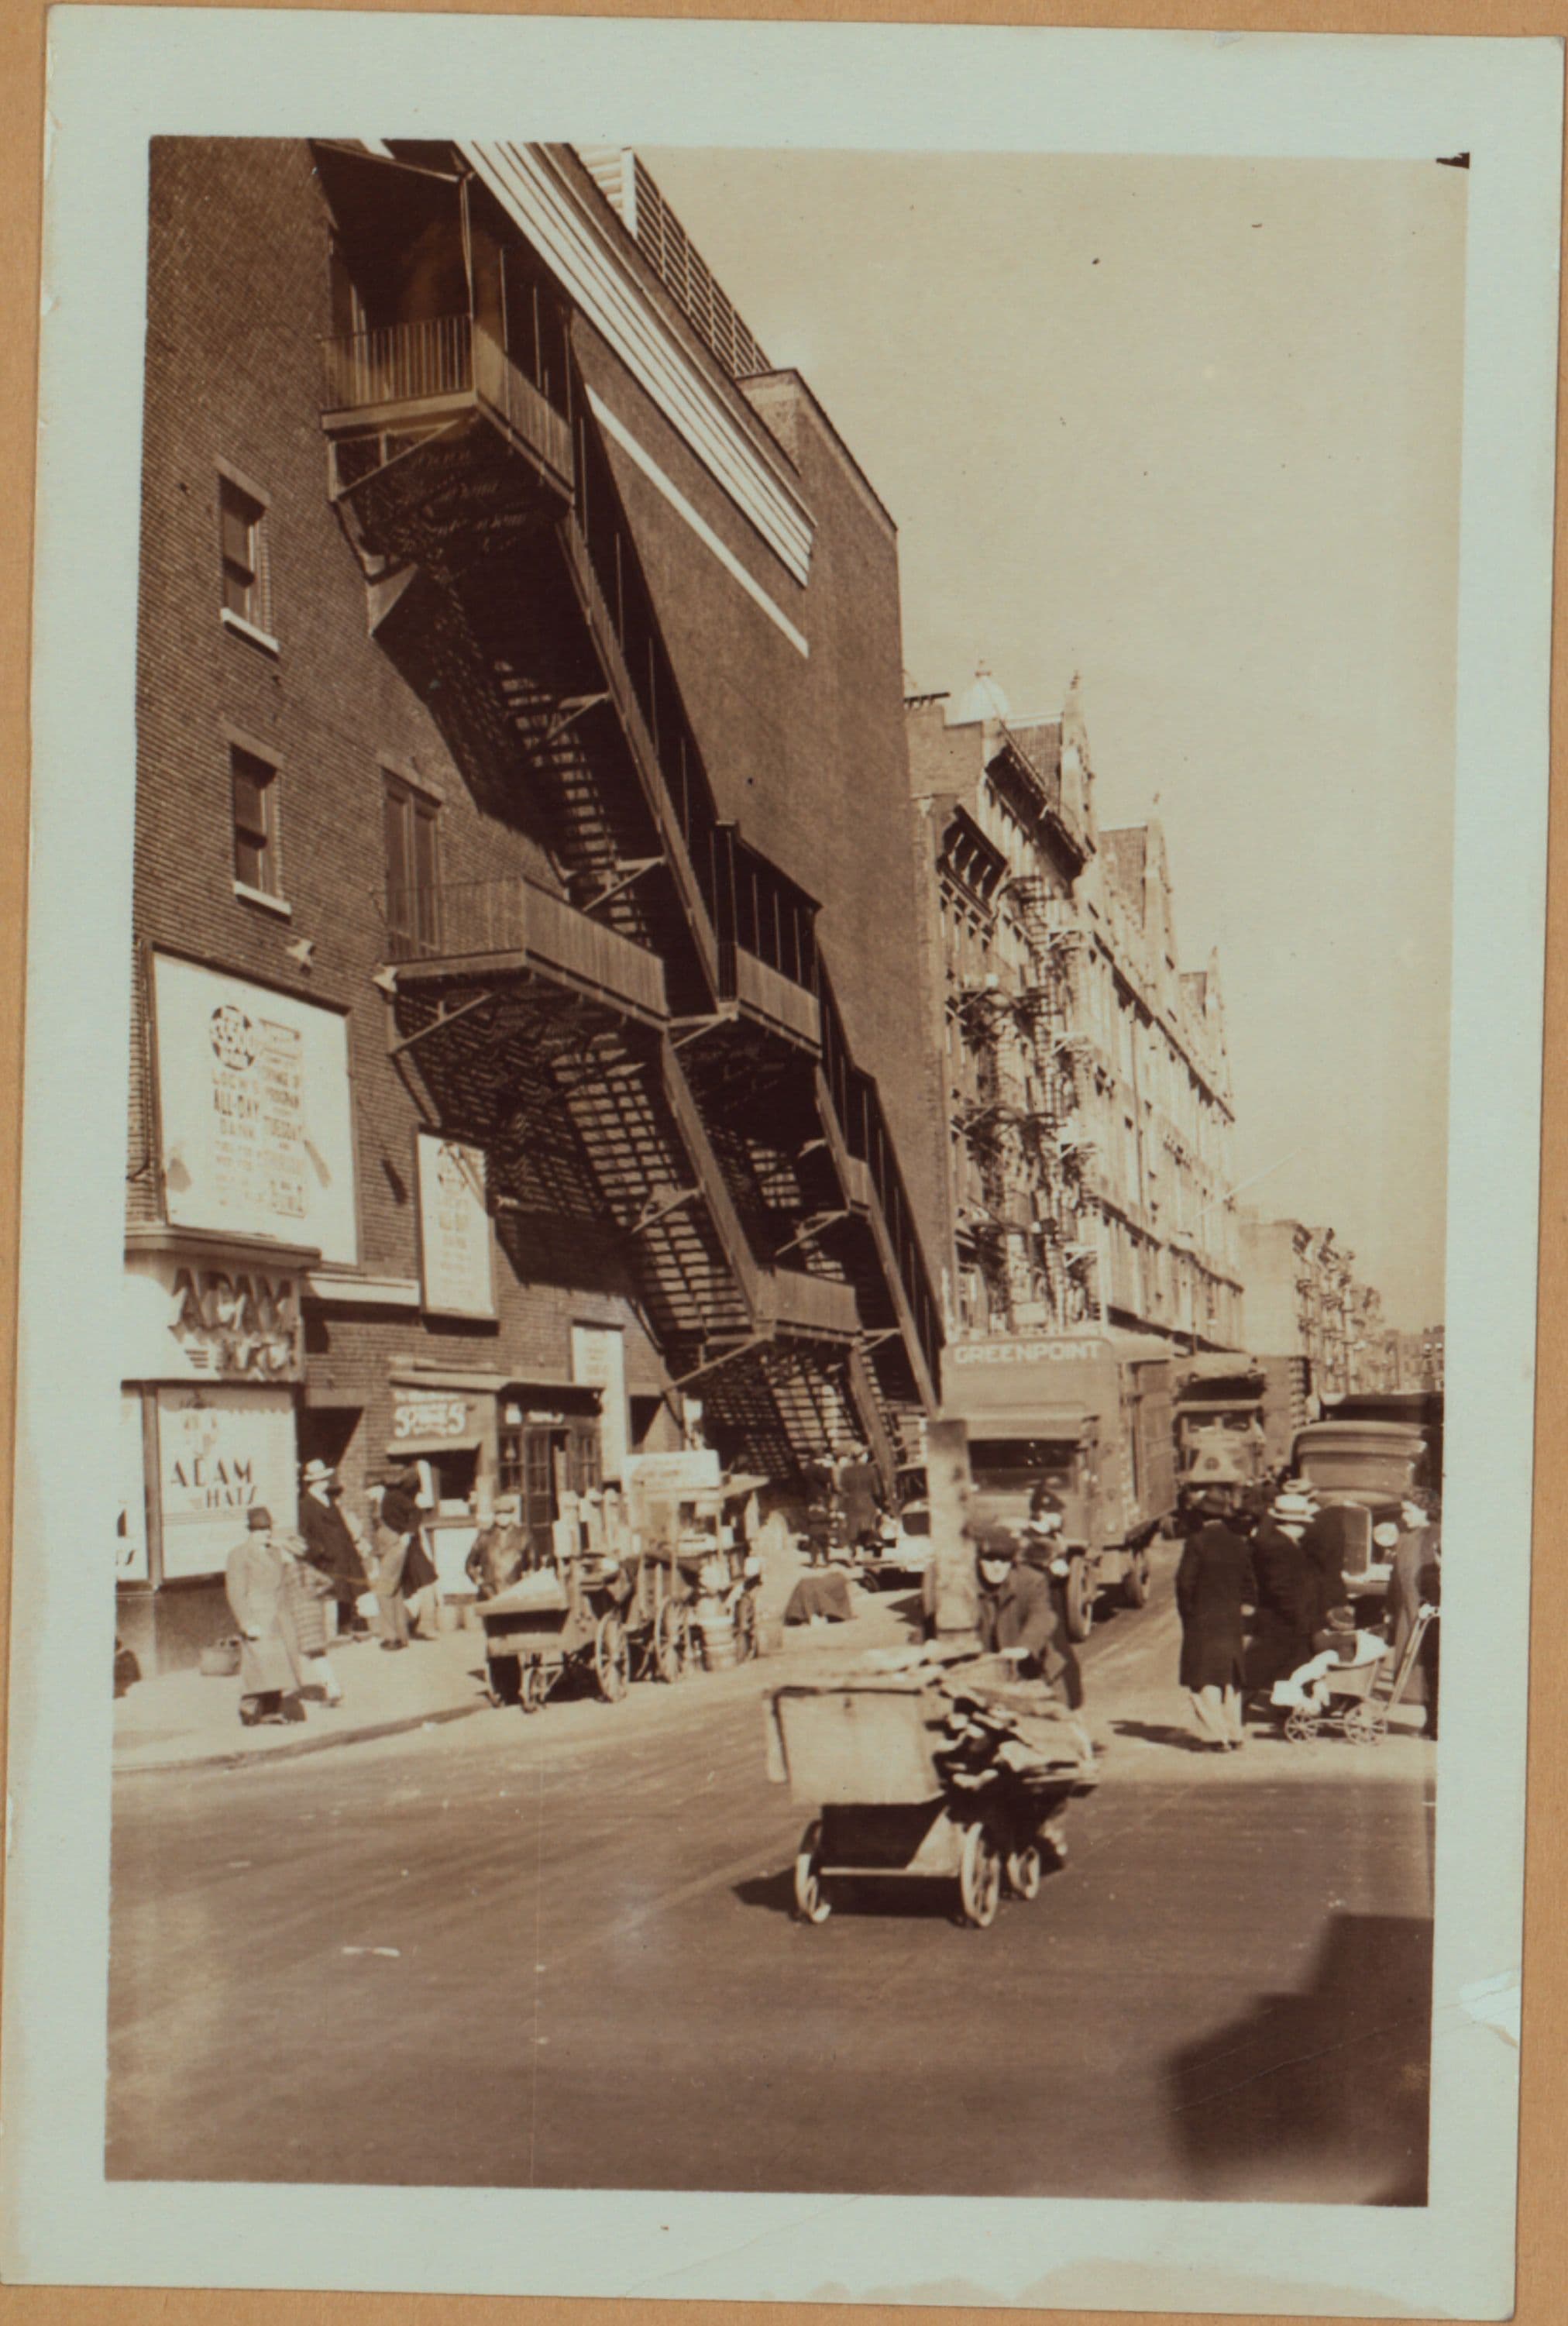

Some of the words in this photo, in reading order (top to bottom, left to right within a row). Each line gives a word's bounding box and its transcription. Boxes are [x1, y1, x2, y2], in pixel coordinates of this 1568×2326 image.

[170, 1267, 293, 1335] ADAM
[957, 1341, 1099, 1363] GREENPOINT
[169, 1457, 252, 1488] ADAM
[206, 1485, 258, 1509] HATS
